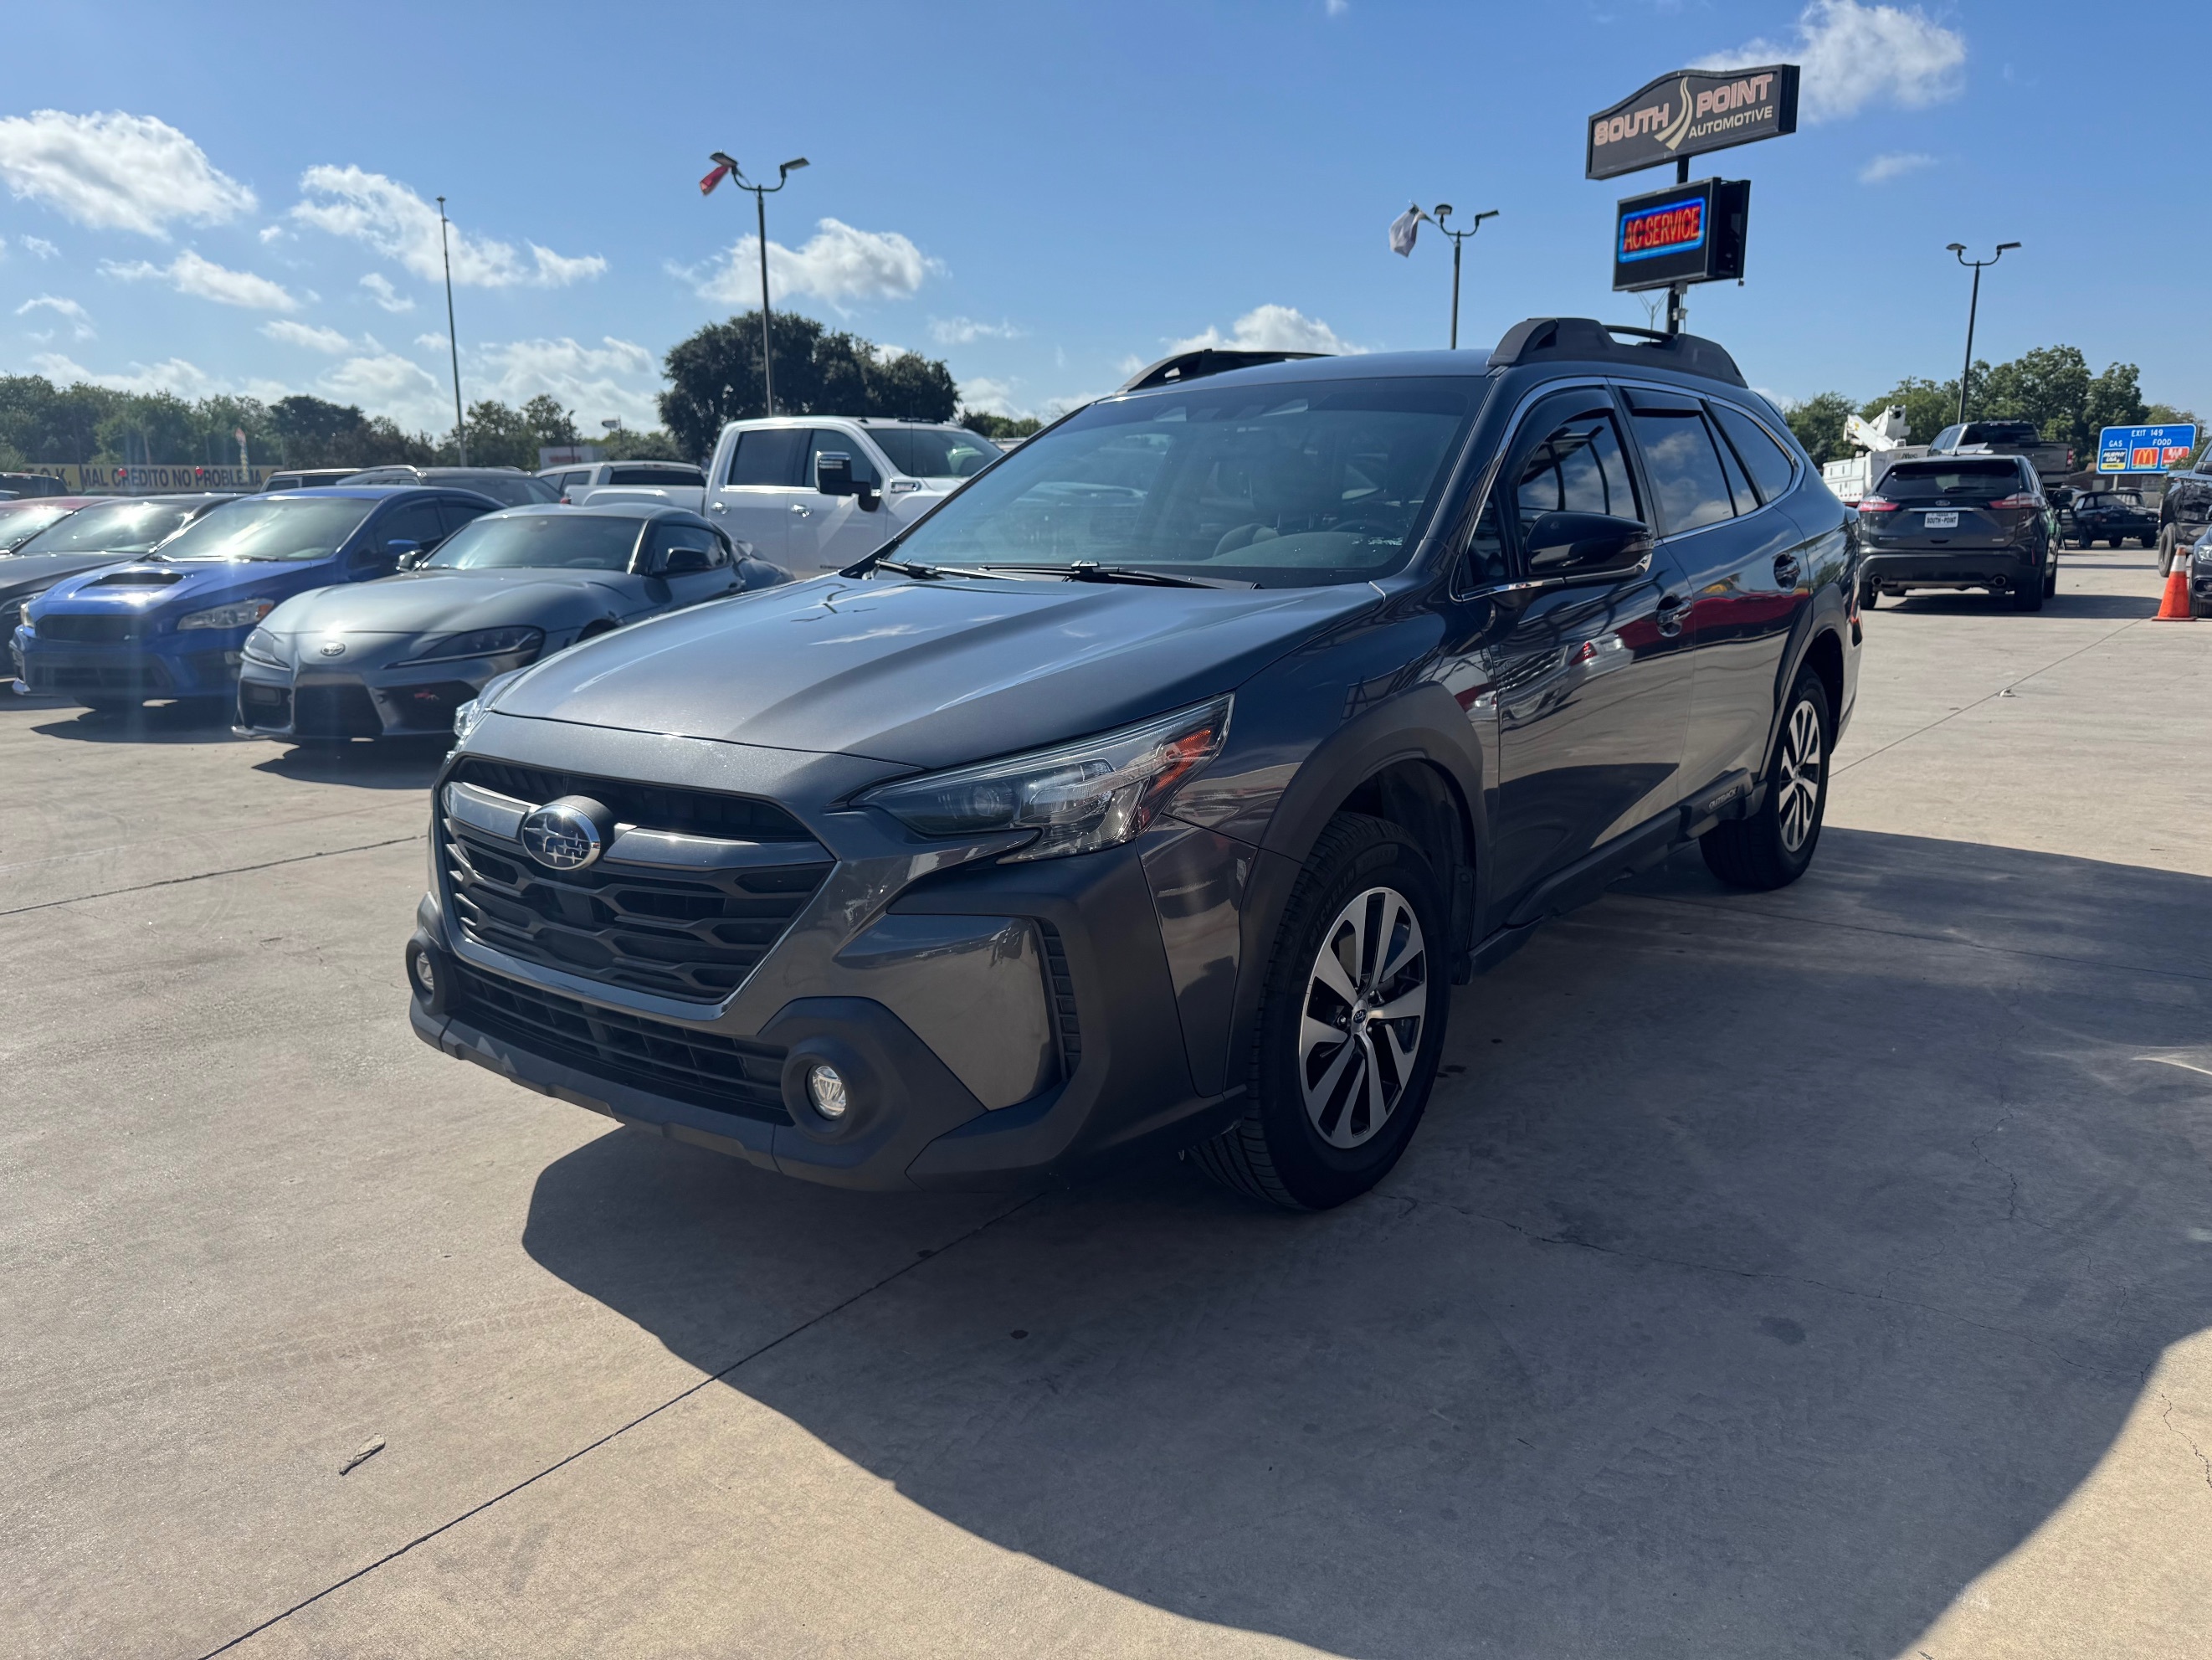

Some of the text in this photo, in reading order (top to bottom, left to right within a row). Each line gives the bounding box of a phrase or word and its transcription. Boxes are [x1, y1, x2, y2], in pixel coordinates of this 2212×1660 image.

[1594, 73, 1773, 146] SOUTH POINT
[1688, 105, 1773, 139] AUTOMOTIVE
[1624, 206, 1700, 250] AC SERVICE
[83, 468, 109, 486] MAL
[172, 468, 192, 486] NO
